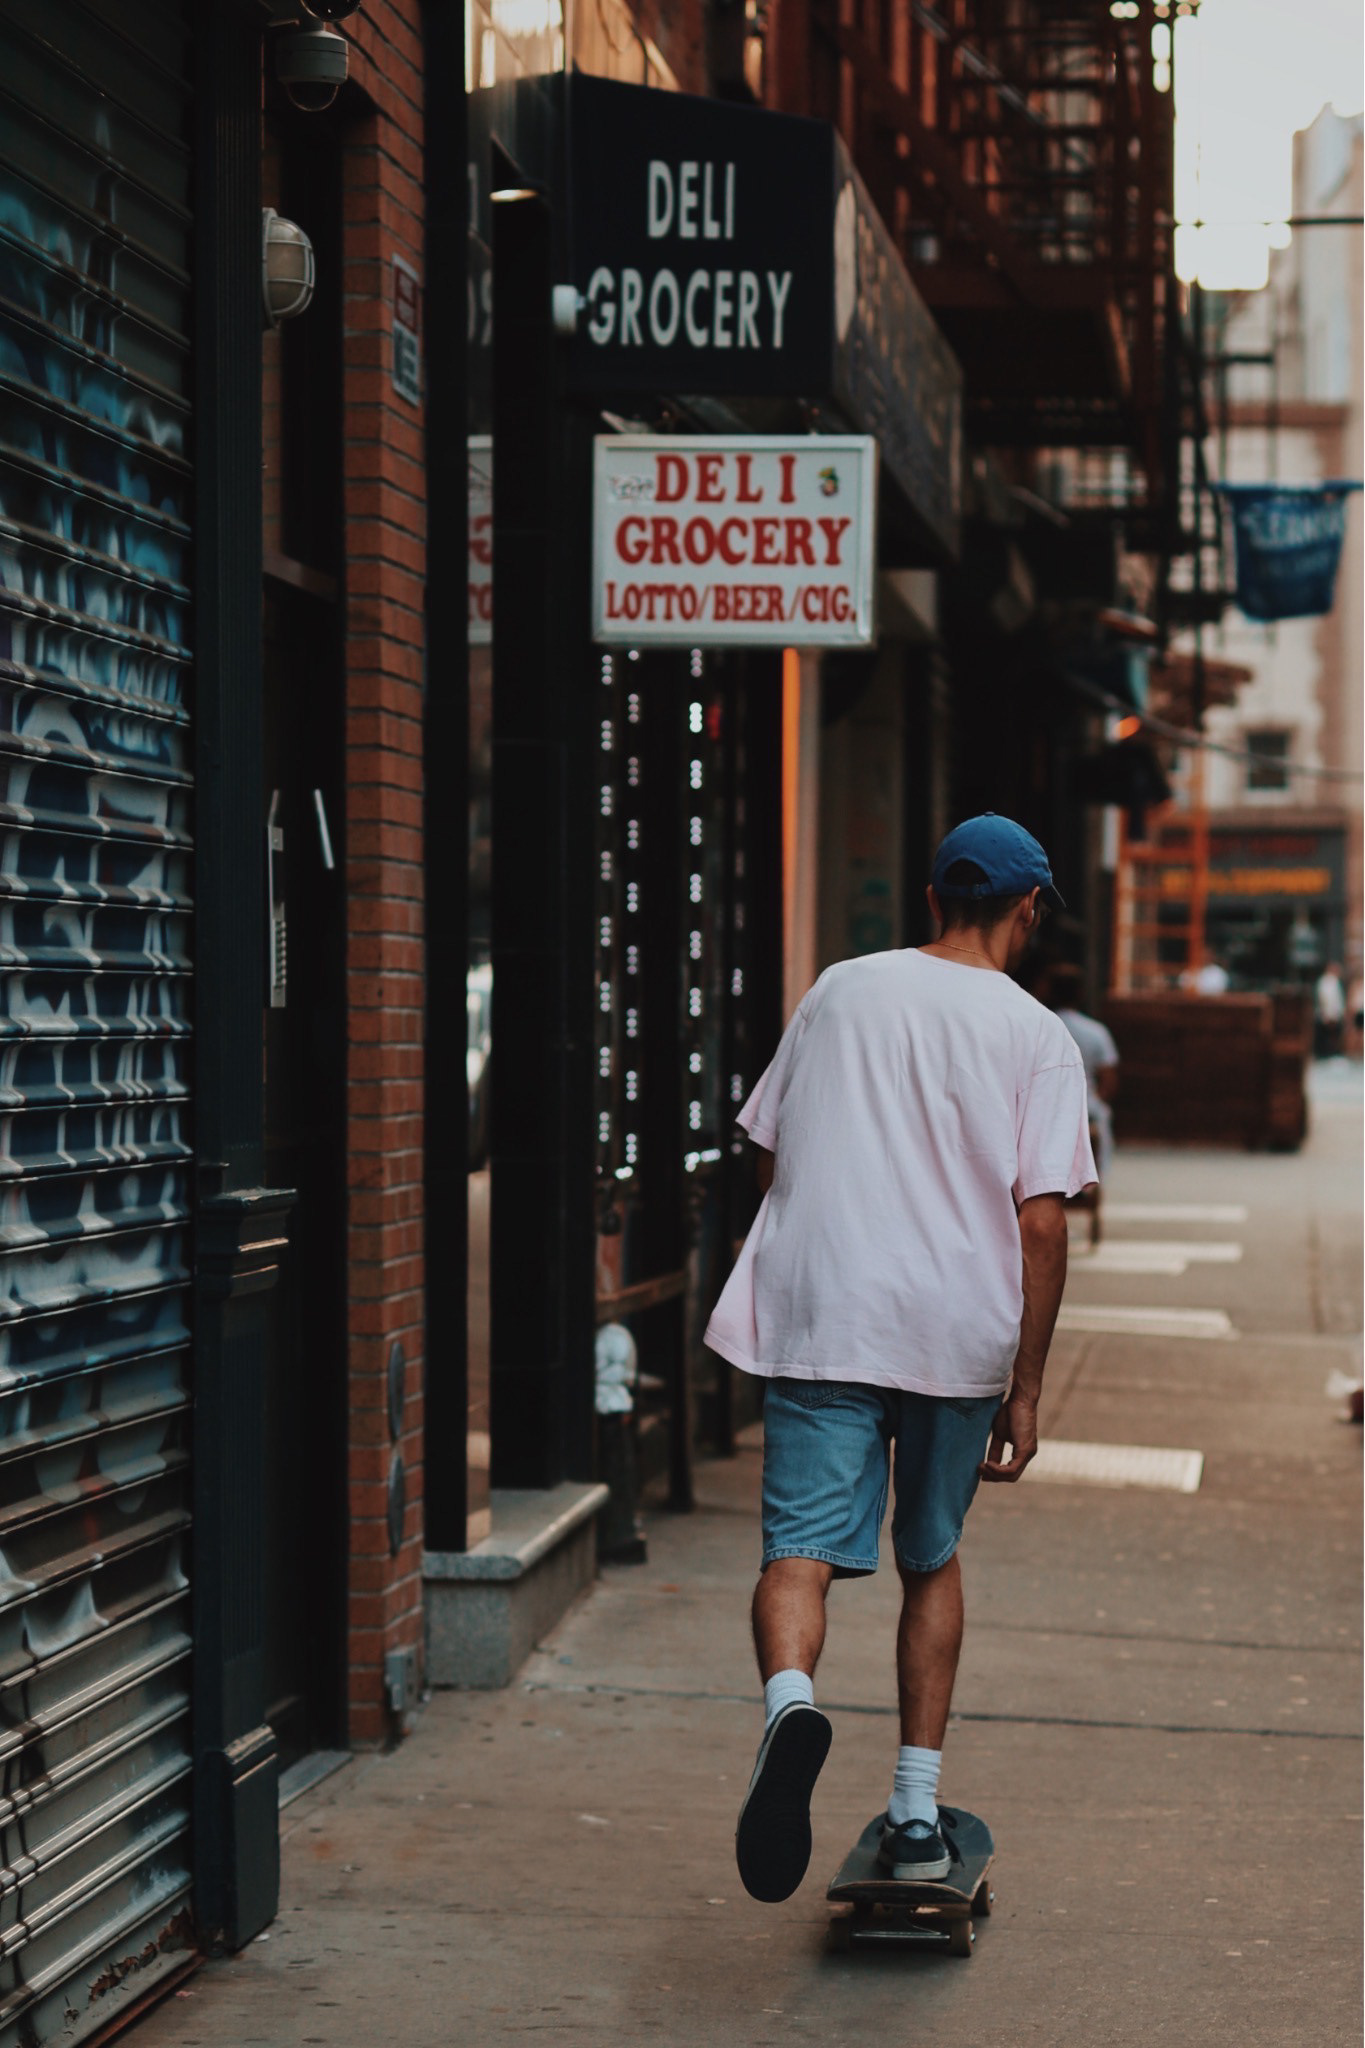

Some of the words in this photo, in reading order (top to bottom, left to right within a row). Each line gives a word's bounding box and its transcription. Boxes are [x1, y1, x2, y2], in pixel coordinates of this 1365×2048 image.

[648, 160, 734, 239] DELI
[588, 267, 792, 349] GROCERY
[655, 454, 796, 503] DELI
[615, 515, 851, 566] GROCERY
